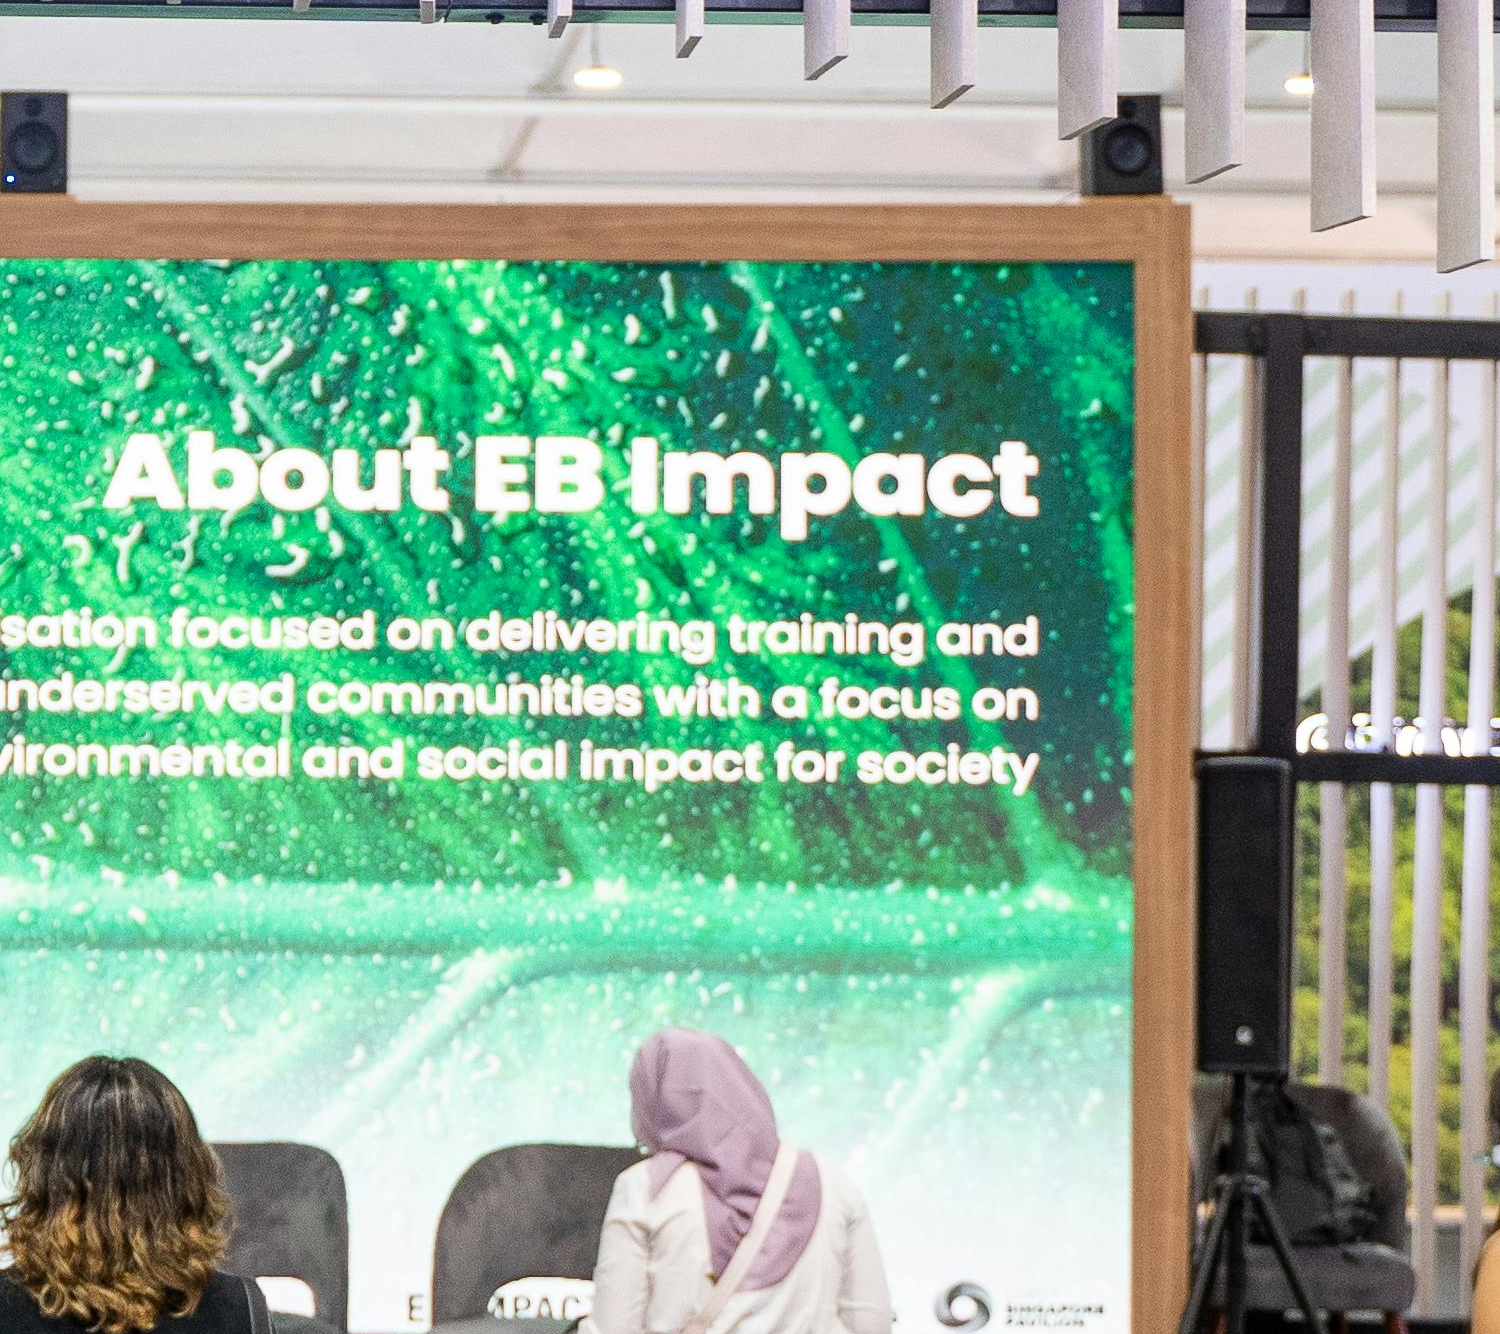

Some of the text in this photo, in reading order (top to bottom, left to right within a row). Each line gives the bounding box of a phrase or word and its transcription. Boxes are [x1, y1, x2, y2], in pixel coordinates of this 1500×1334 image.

[102, 433, 1040, 542] About EB Impact
[171, 608, 375, 651] focused
[386, 622, 455, 656] on
[465, 609, 716, 666] delivering
[728, 612, 925, 667] training
[936, 614, 1039, 658] and
[306, 675, 642, 719] communities
[653, 676, 760, 720] with
[771, 684, 807, 720] a
[818, 676, 961, 721] focus
[972, 685, 1039, 722] on
[302, 739, 403, 781] and
[417, 739, 568, 783] social
[580, 740, 763, 792] impact
[775, 741, 848, 784] for
[857, 743, 1039, 796] society
